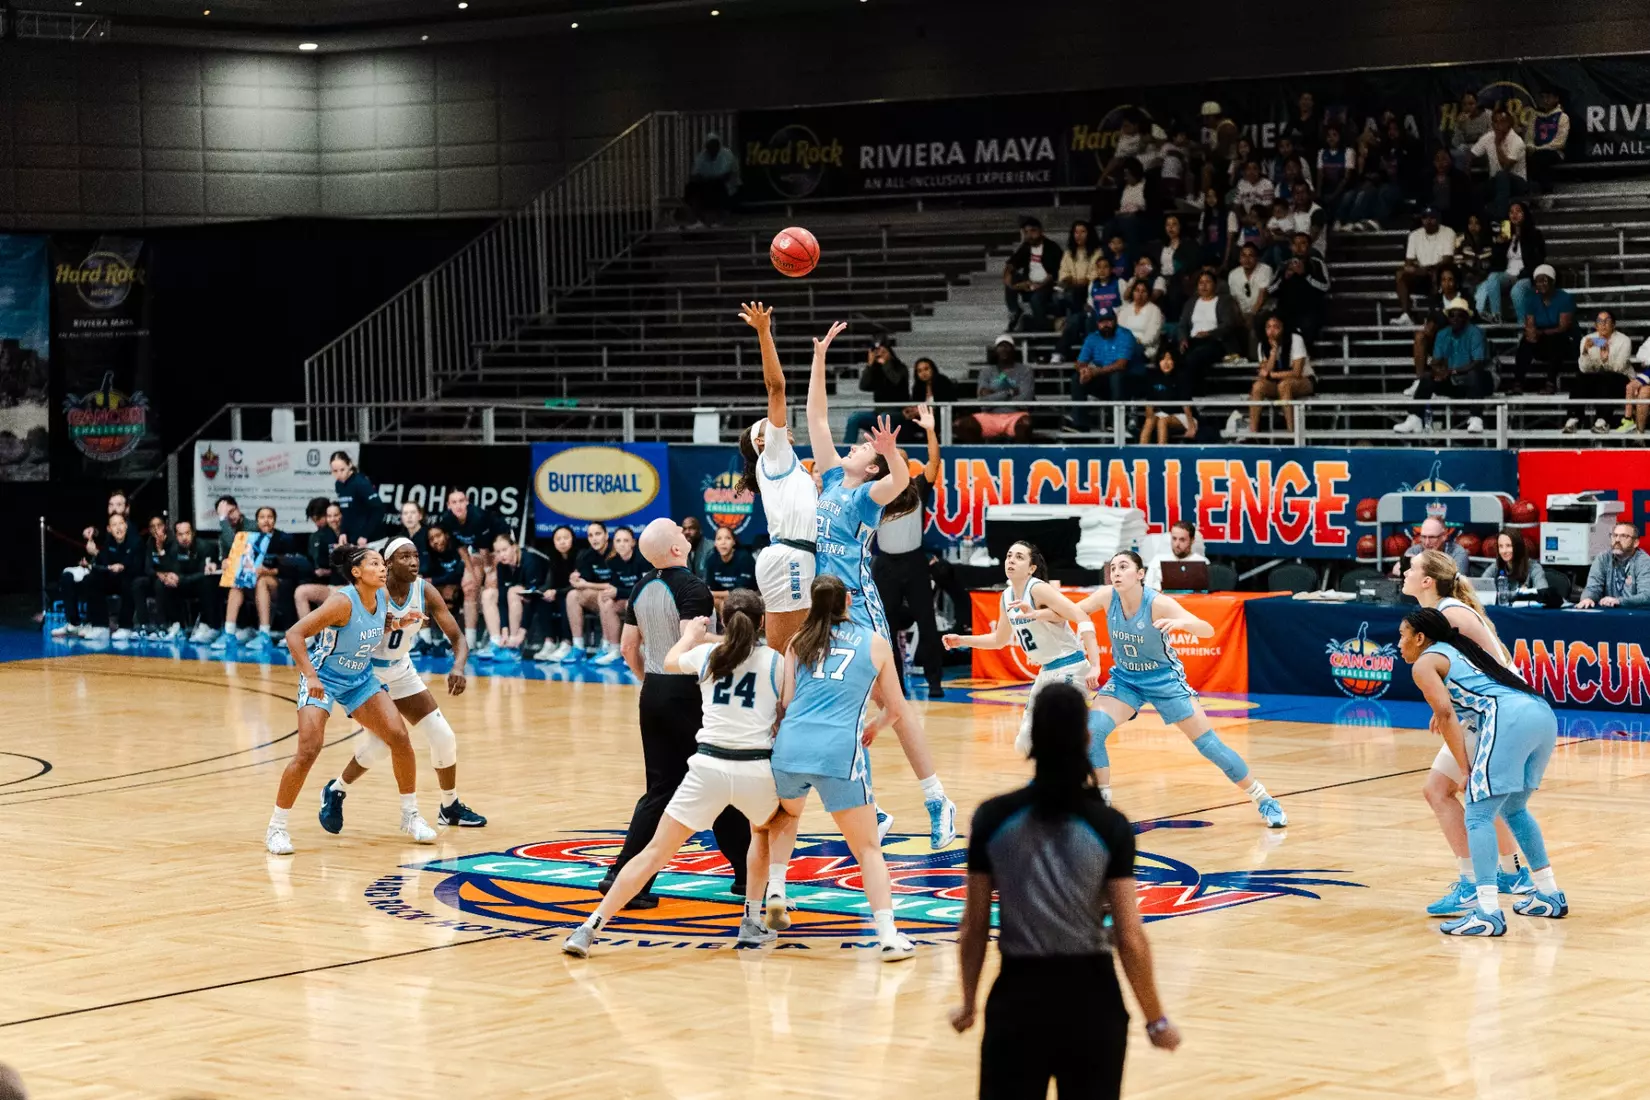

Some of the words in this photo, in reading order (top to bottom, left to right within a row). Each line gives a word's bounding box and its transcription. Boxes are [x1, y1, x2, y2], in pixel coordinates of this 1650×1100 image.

[745, 140, 792, 167] Hard
[795, 137, 843, 169] Rock
[859, 140, 967, 169] RIVIERA
[973, 136, 1056, 164] MAYA
[1592, 143, 1614, 156] AN
[864, 177, 881, 188] AN
[975, 170, 1050, 184] EXPERIENCE
[55, 262, 104, 285] Hard
[547, 471, 642, 495] BUTTERBALL
[1021, 458, 1350, 546] CHALLENGE
[388, 628, 403, 650] 0
[1112, 629, 1145, 645] NORTH
[1175, 646, 1221, 657] XPERIENCE
[1329, 652, 1394, 673] CANCUN
[811, 647, 856, 682] 17
[1334, 668, 1389, 681] CHALLENGE
[712, 671, 757, 709] 24
[364, 874, 417, 898] HARD
[367, 898, 437, 921] ROCK
[424, 919, 559, 941] HOTEL
